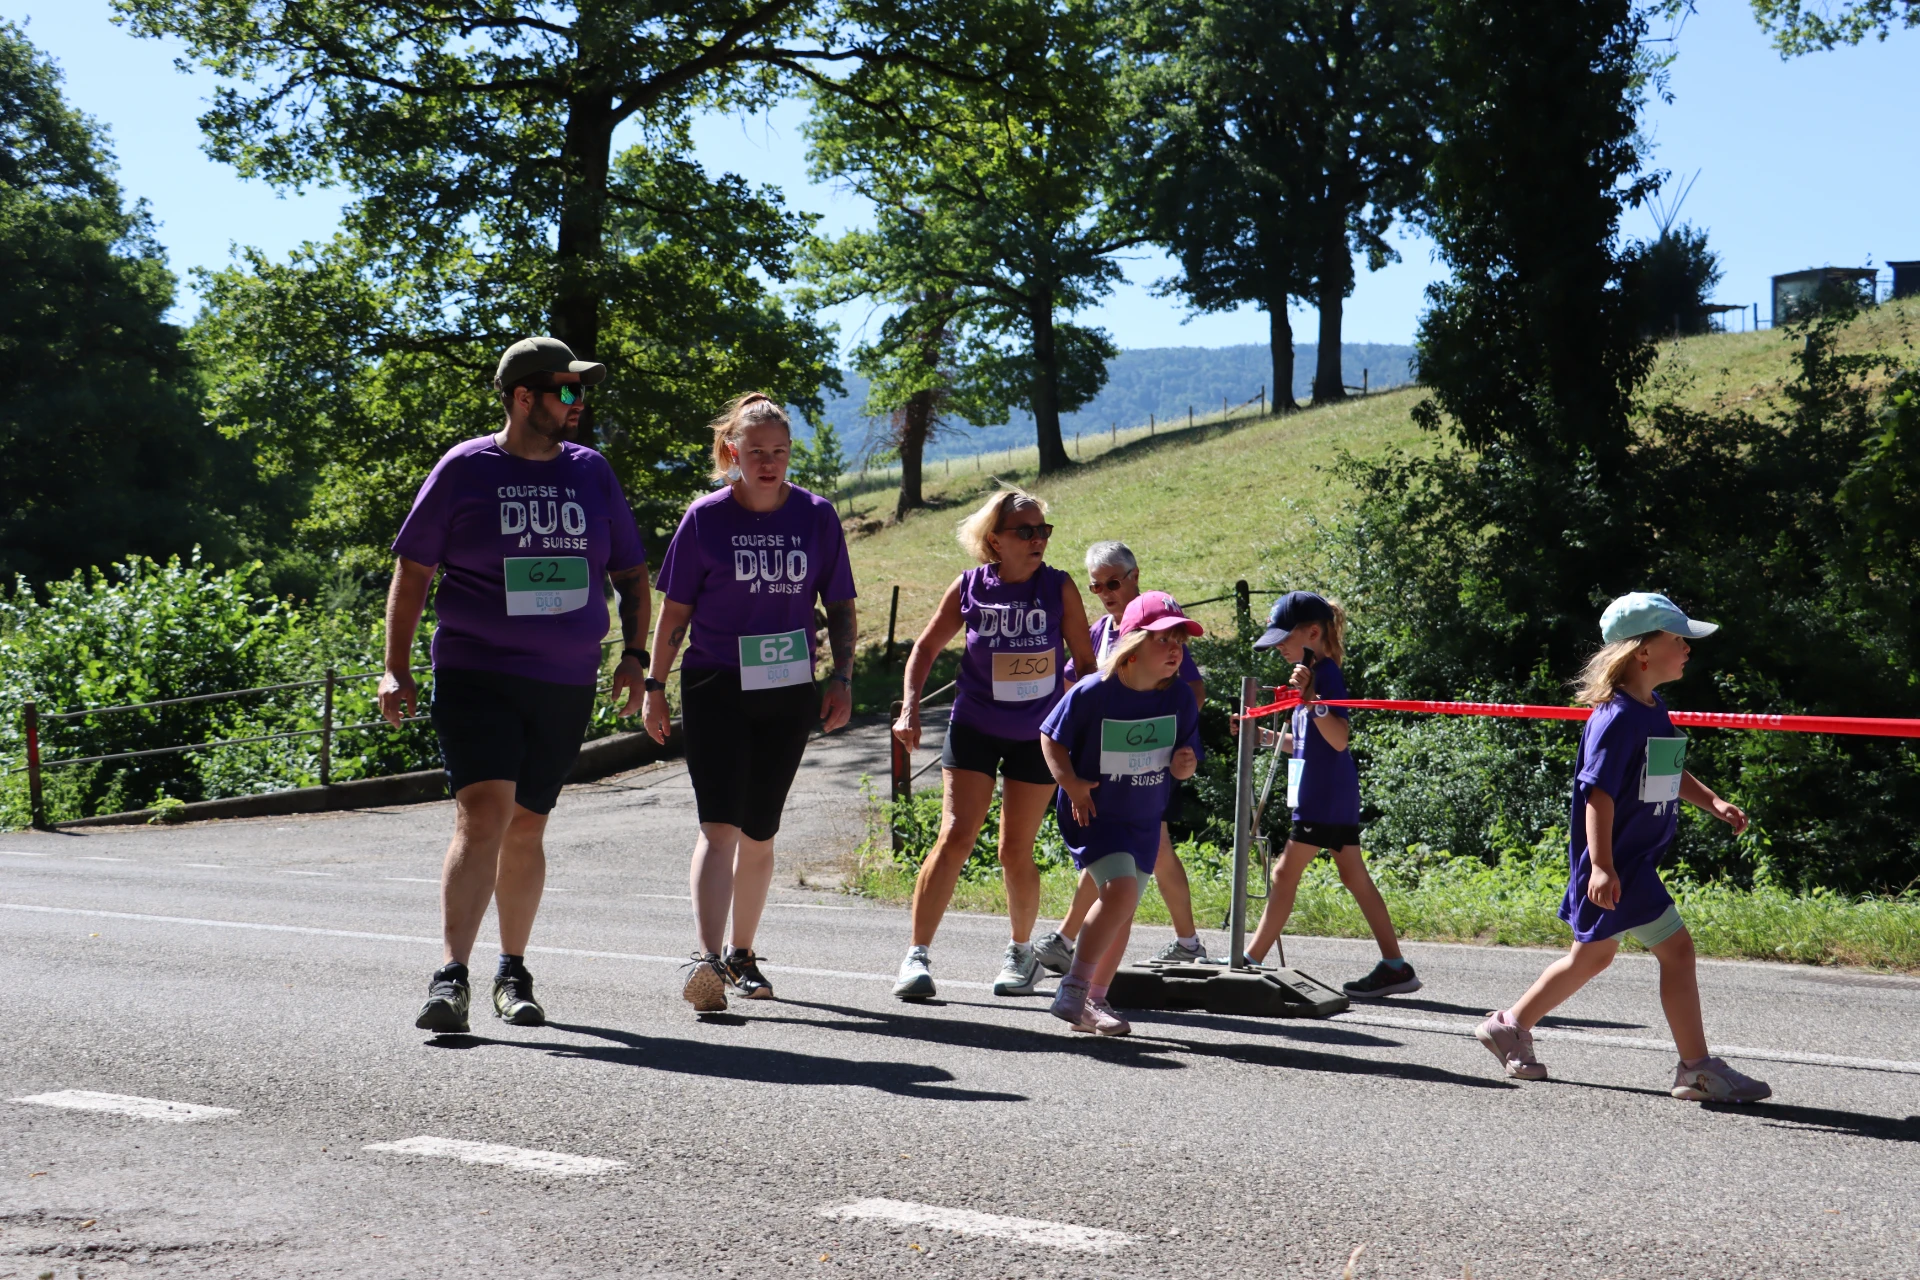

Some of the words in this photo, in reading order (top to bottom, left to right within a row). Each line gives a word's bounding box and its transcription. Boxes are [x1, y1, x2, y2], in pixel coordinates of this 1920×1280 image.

[497, 485, 558, 499] COURSE
[500, 500, 587, 536] DUO
[542, 536, 588, 550] SUISSE
[731, 534, 785, 547] COURSE
[528, 561, 566, 583] 62
[734, 549, 808, 583] DUO
[768, 583, 804, 595] SUISSE
[536, 596, 562, 607] DUO
[977, 608, 1047, 638] DUO
[759, 636, 794, 663] 62
[1009, 635, 1049, 648] SUISSE
[1008, 657, 1049, 676] 150
[1126, 722, 1158, 746] 62
[1130, 772, 1165, 787] SUISSE
